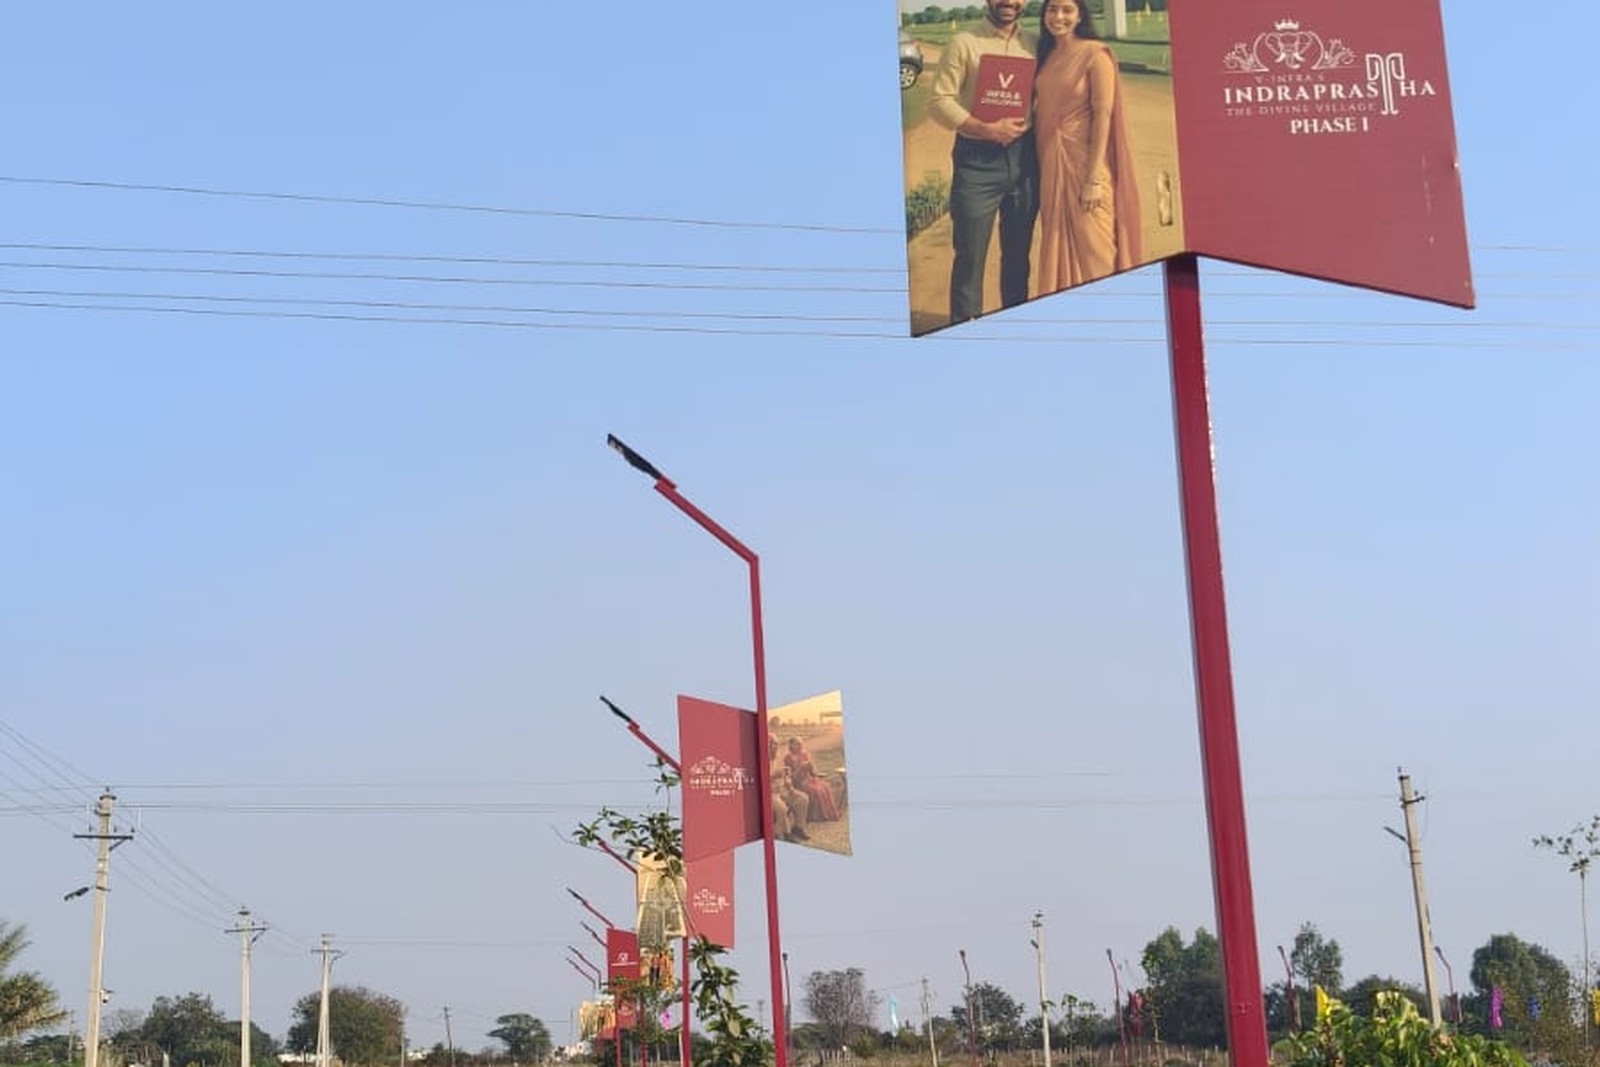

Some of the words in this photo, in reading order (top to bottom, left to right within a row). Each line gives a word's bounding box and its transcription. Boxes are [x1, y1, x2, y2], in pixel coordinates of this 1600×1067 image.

[998, 71, 1014, 89] V
[1223, 53, 1437, 115] INDRAPRASTHA
[1226, 106, 1253, 117] THE
[1258, 104, 1309, 115] DIVINE
[1315, 102, 1376, 113] VILLAGE
[1290, 117, 1357, 134] PHASE
